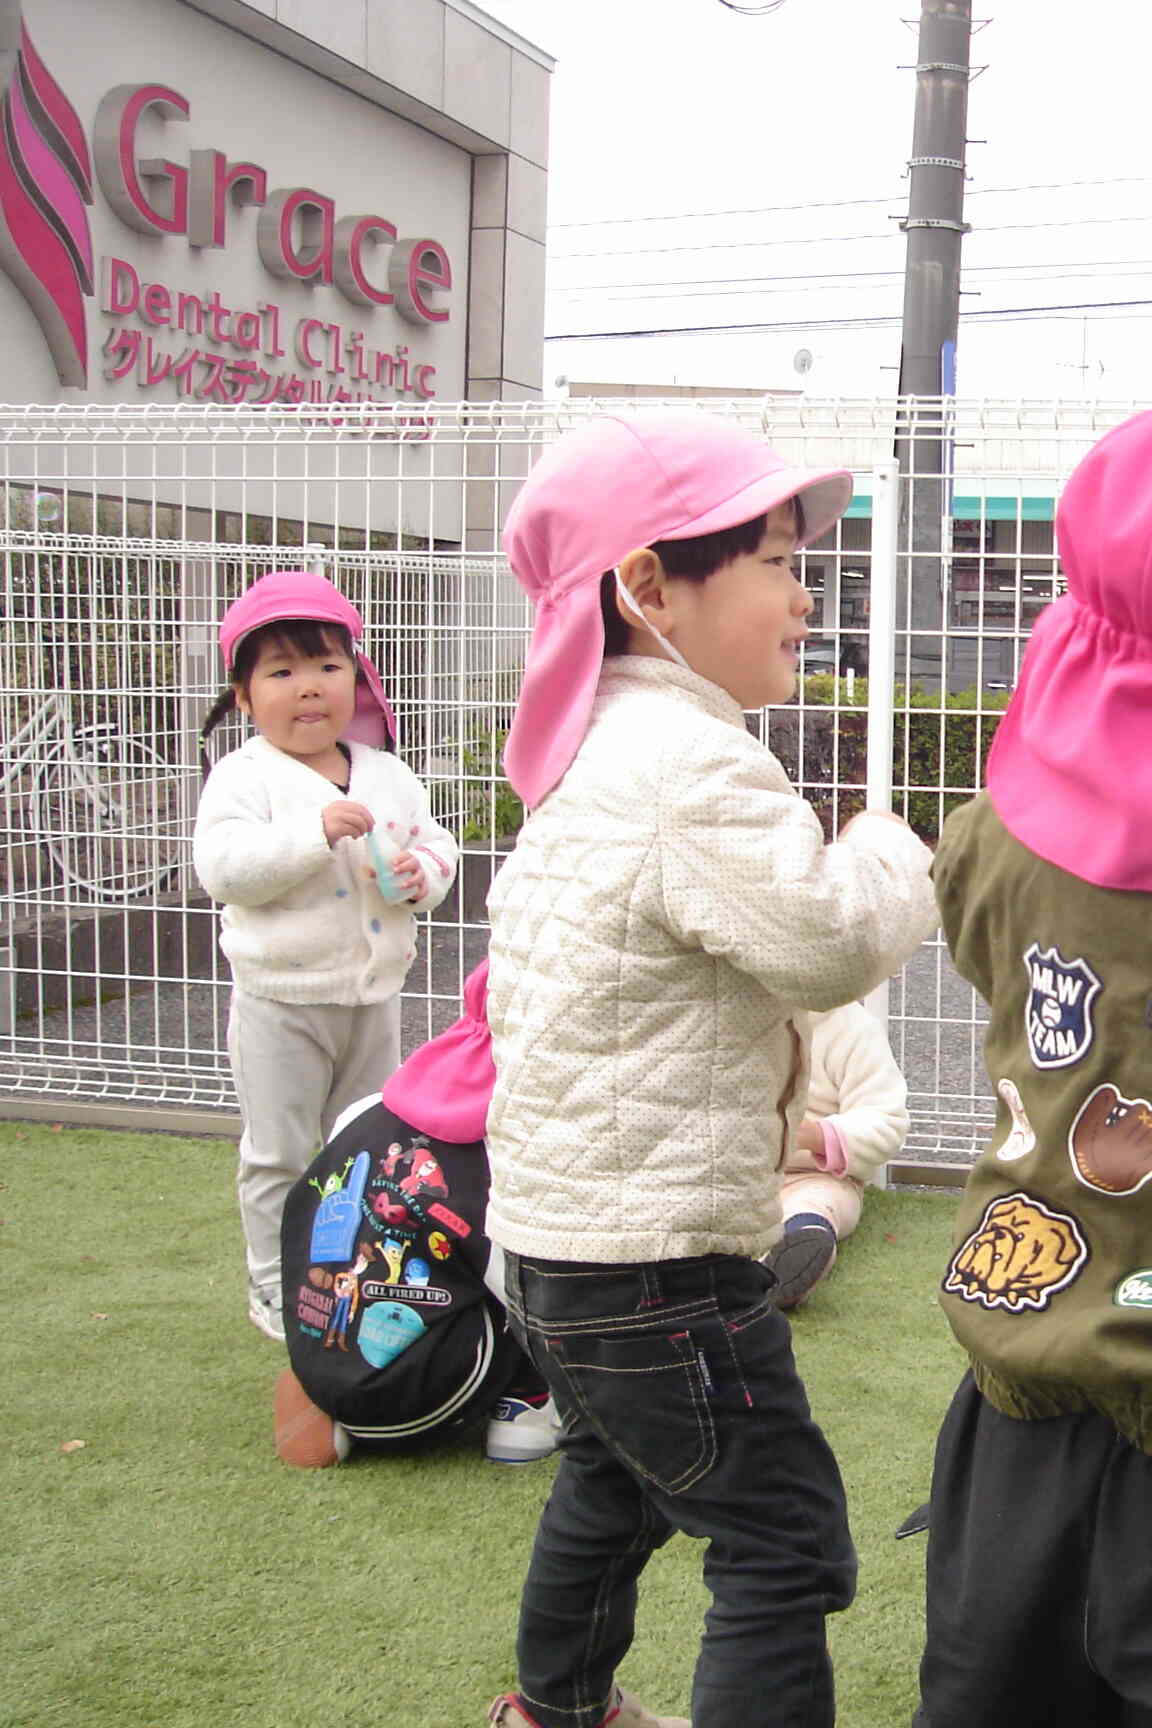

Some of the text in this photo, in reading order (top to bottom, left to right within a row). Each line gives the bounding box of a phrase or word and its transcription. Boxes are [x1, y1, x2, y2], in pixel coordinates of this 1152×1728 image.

[97, 83, 453, 324] Grace
[104, 257, 437, 398] Dental Clinic
[1032, 962, 1083, 1006] MLW
[1030, 1009, 1077, 1056] TEAM
[366, 1285, 388, 1297] ALL
[388, 1287, 425, 1301] FIRED
